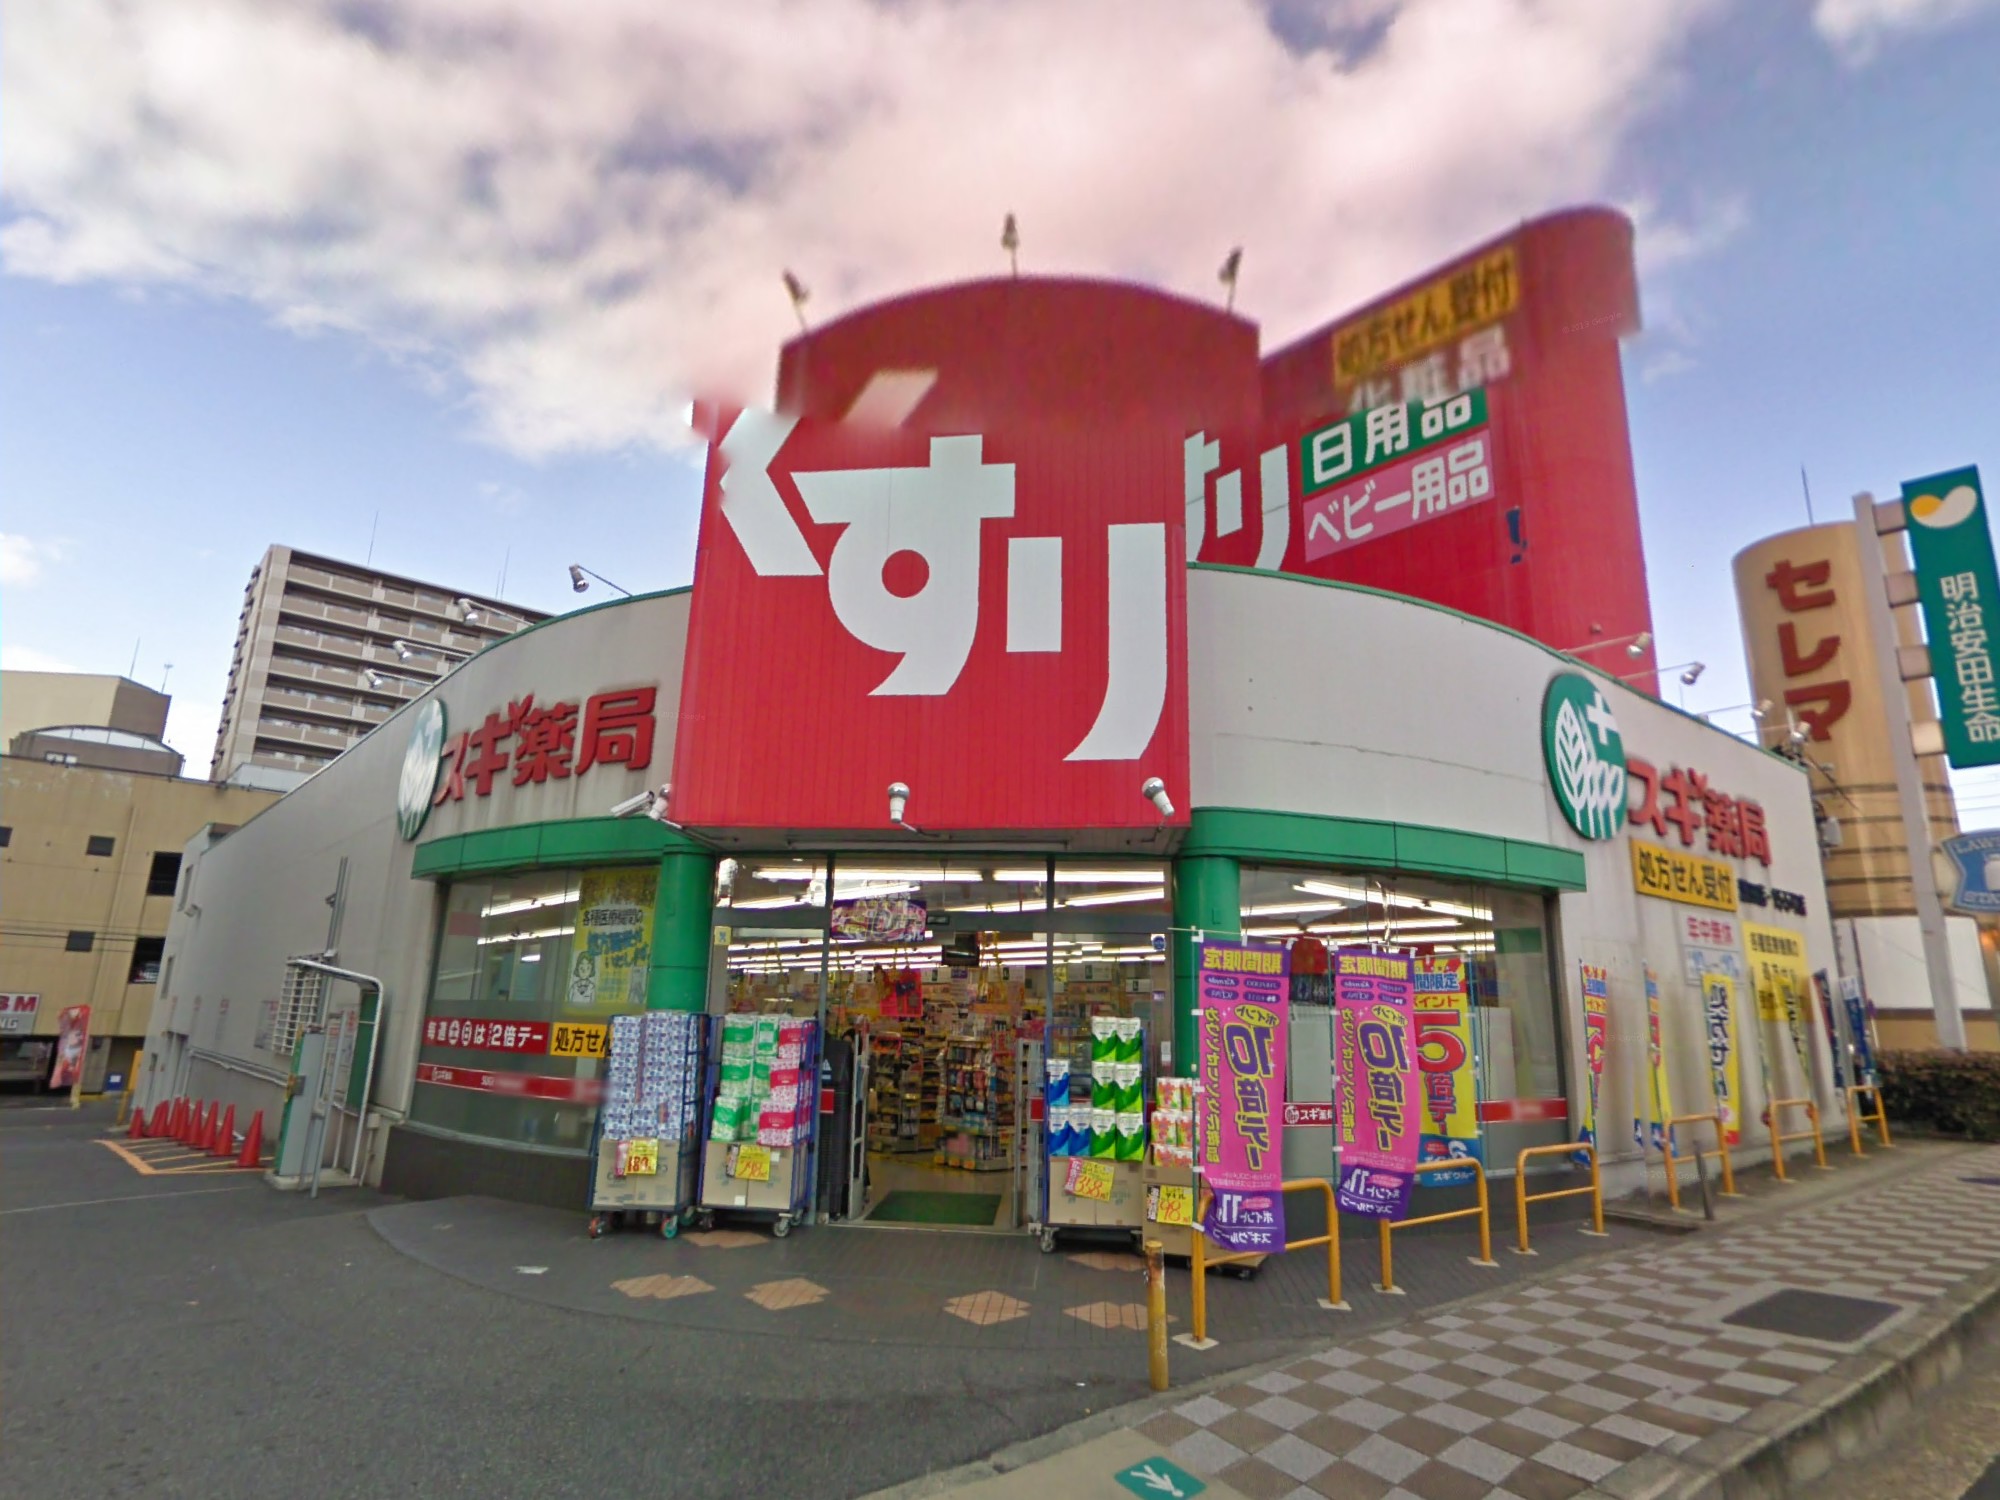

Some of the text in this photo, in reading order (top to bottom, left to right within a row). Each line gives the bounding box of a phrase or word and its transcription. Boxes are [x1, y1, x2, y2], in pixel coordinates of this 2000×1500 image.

[1308, 440, 1490, 541] ベビー用品
[1312, 393, 1473, 484] 日用品
[716, 371, 1167, 762] くすり
[1765, 558, 1852, 742] セレマ
[1939, 570, 2000, 744] 明治安田生命
[433, 686, 657, 806] スギ薬局
[1626, 757, 1772, 867] スギ薬局
[1638, 847, 1733, 905] 処方せん受付
